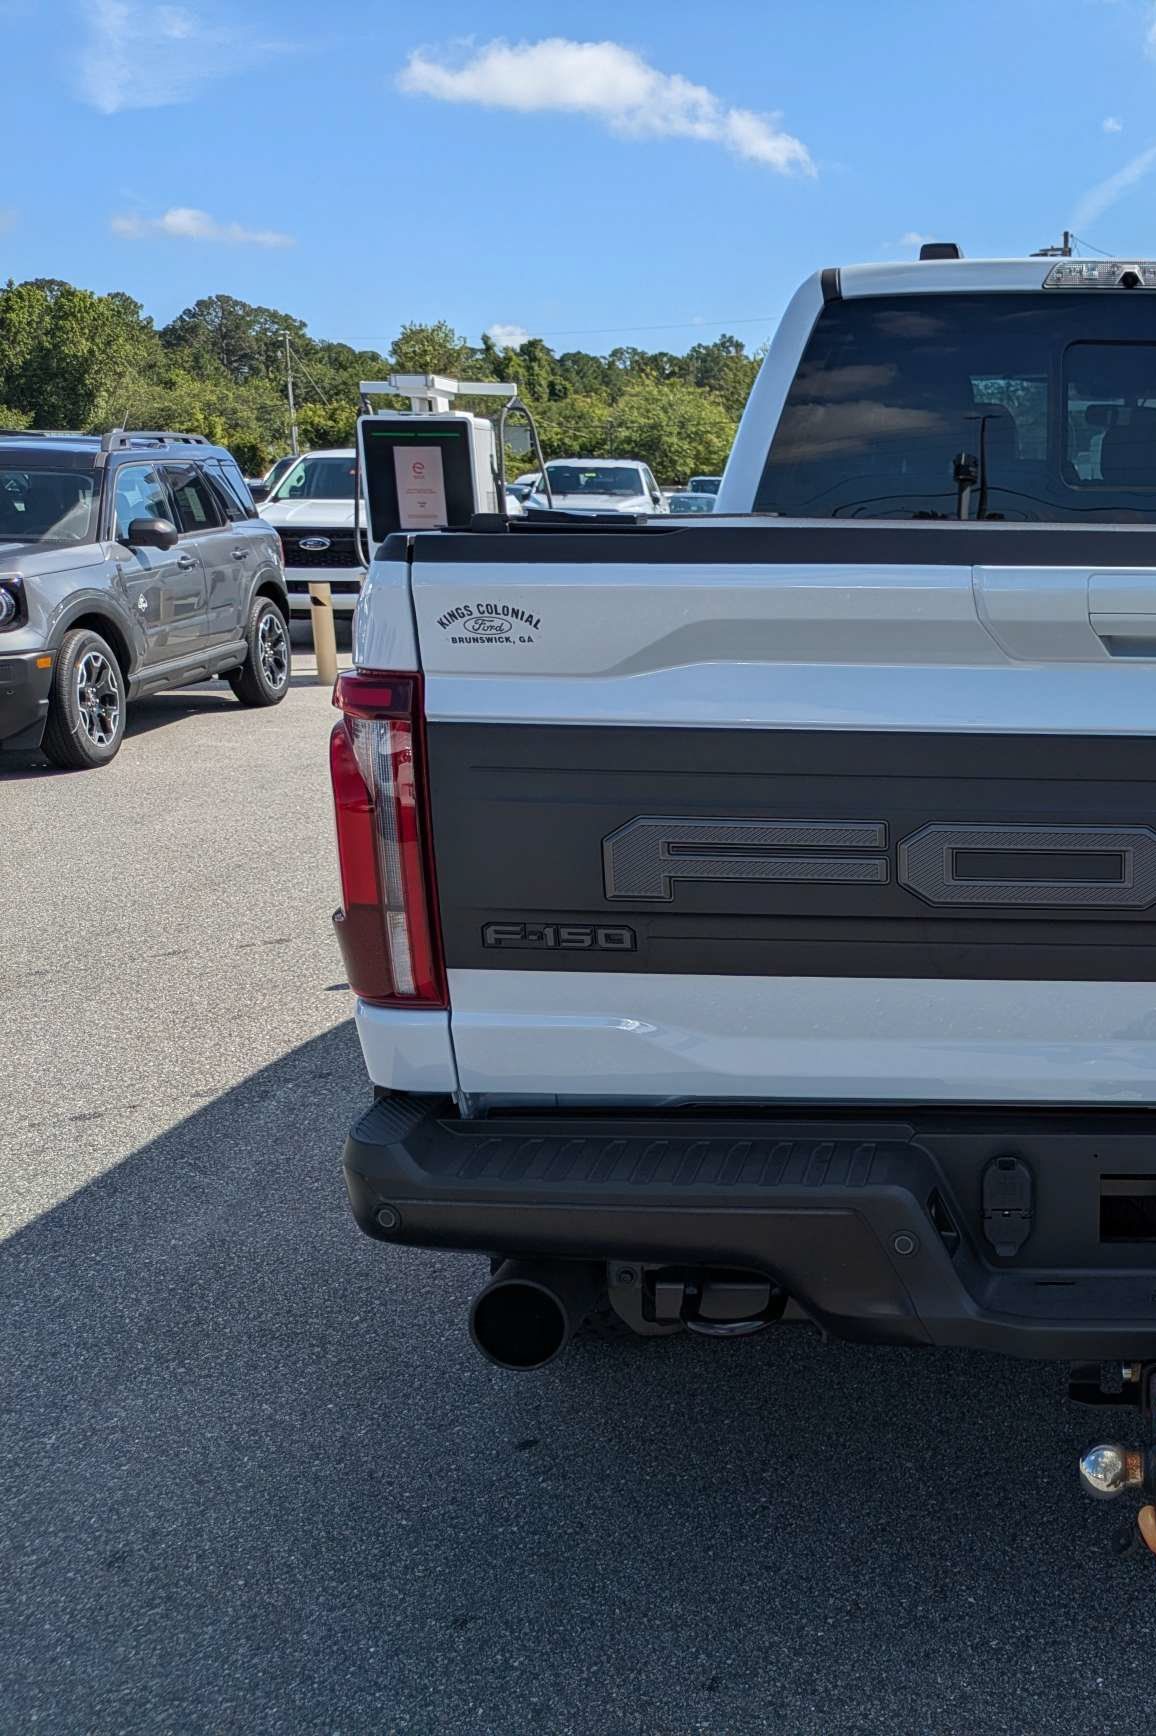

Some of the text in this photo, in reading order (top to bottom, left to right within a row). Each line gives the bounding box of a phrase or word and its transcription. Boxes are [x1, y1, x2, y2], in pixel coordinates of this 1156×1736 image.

[436, 603, 542, 630] KINGS COLONIAL
[471, 618, 505, 632] Ford
[451, 635, 535, 645] BRUNSWICK, GA
[482, 922, 637, 951] F-150
